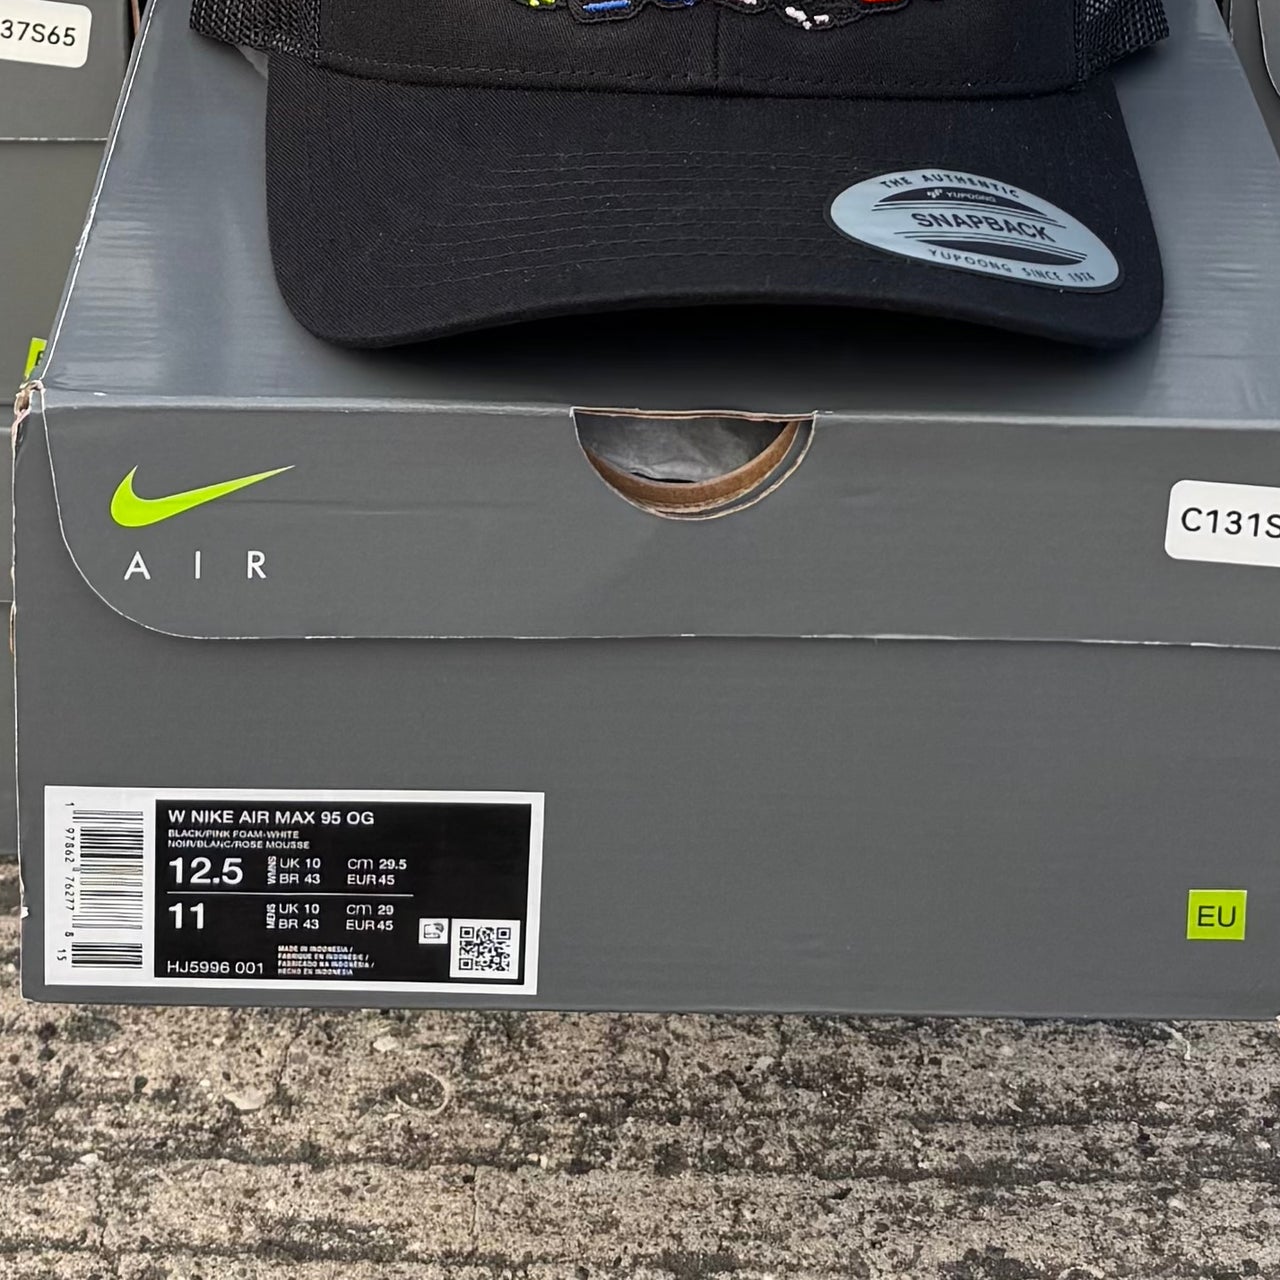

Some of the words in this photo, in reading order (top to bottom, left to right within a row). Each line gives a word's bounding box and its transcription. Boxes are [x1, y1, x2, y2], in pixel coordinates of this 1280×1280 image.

[881, 176, 912, 189] THE
[923, 173, 1020, 199] AUTHENTIC
[912, 212, 1056, 243] SNAPBACK
[929, 248, 1012, 273] YUPOONG
[1022, 267, 1060, 282] SINCE
[123, 550, 267, 581] AIR
[168, 809, 186, 824] W
[191, 809, 234, 824] NIKE
[239, 810, 270, 825] AIR
[275, 810, 315, 825] MAX
[320, 810, 342, 825] 95
[346, 810, 374, 825] OG
[168, 857, 243, 885] 12.5
[279, 858, 300, 869] UK
[305, 858, 321, 869] 10
[347, 859, 373, 871] cm
[378, 859, 407, 871] 29.5
[279, 873, 299, 884] BR
[304, 873, 321, 885] 43
[347, 874, 377, 886] EUR
[378, 874, 395, 886] 45
[168, 903, 205, 929] 11
[279, 903, 299, 914] UK
[304, 903, 320, 915] 10
[346, 905, 373, 916] cm
[378, 905, 394, 916] 29
[1198, 905, 1236, 927] EU
[278, 919, 298, 930] BR
[303, 919, 319, 930] 43
[346, 920, 375, 931] EUR
[377, 920, 394, 932] 45
[167, 960, 230, 975] HJ5996
[235, 961, 264, 975] 001
